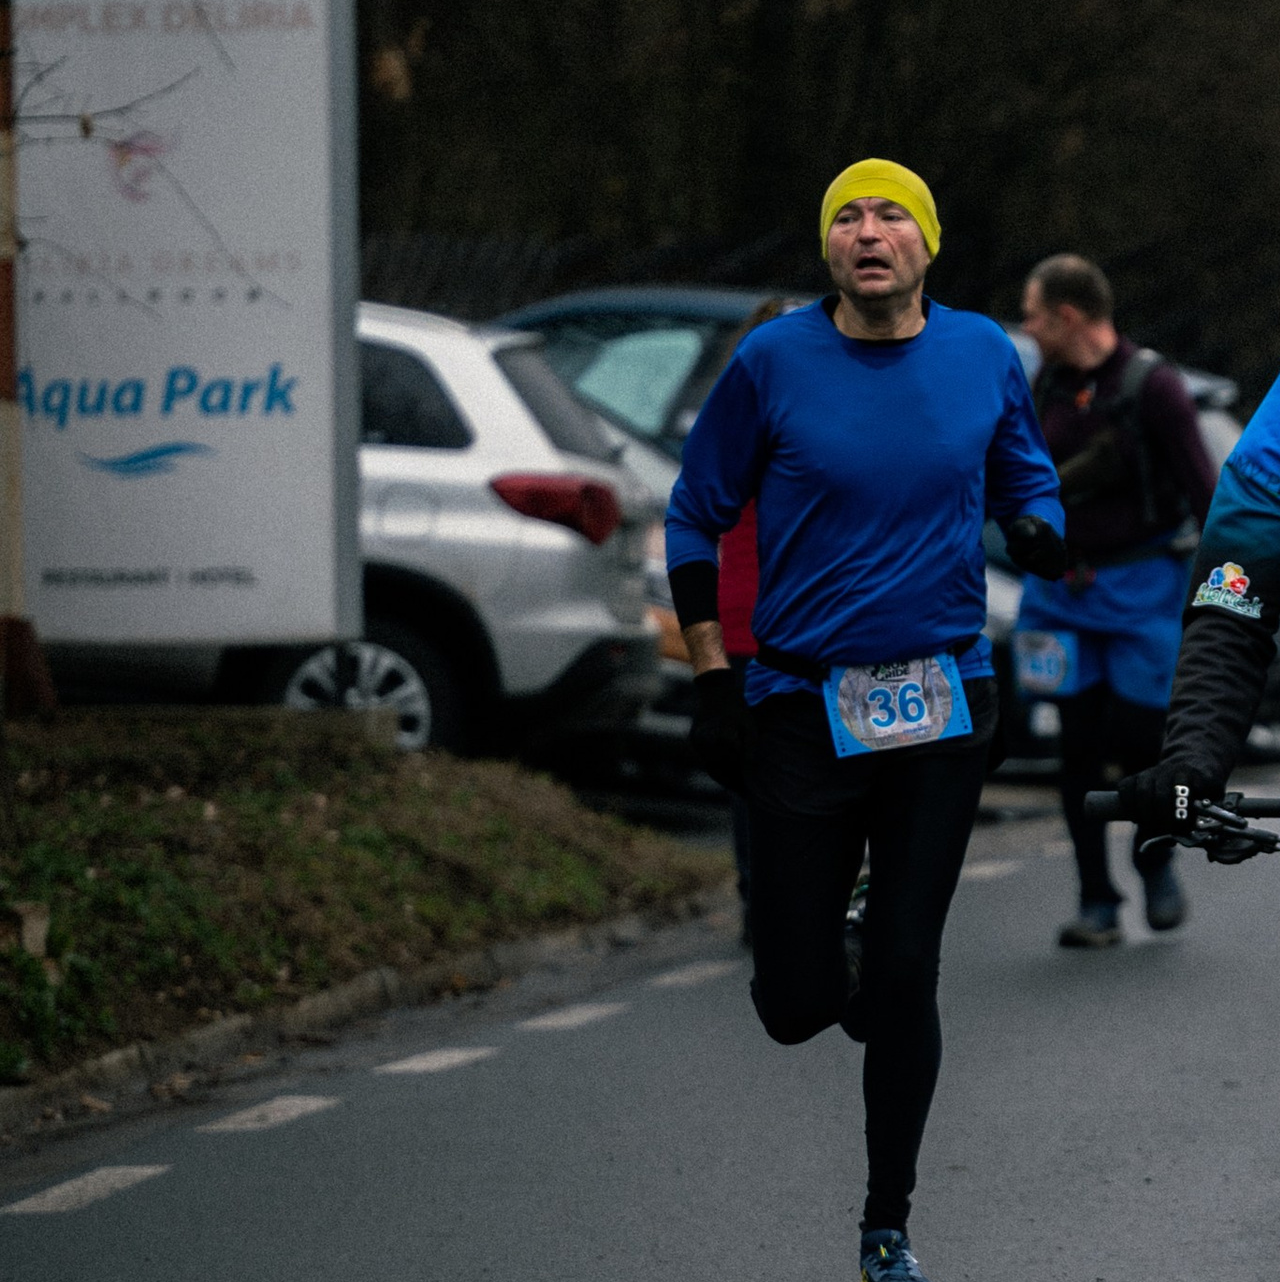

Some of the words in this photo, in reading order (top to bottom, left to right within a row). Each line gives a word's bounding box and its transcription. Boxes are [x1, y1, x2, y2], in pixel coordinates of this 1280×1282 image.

[18, 365, 147, 431] Aqua
[161, 362, 298, 417] Park
[867, 681, 927, 728] 36
